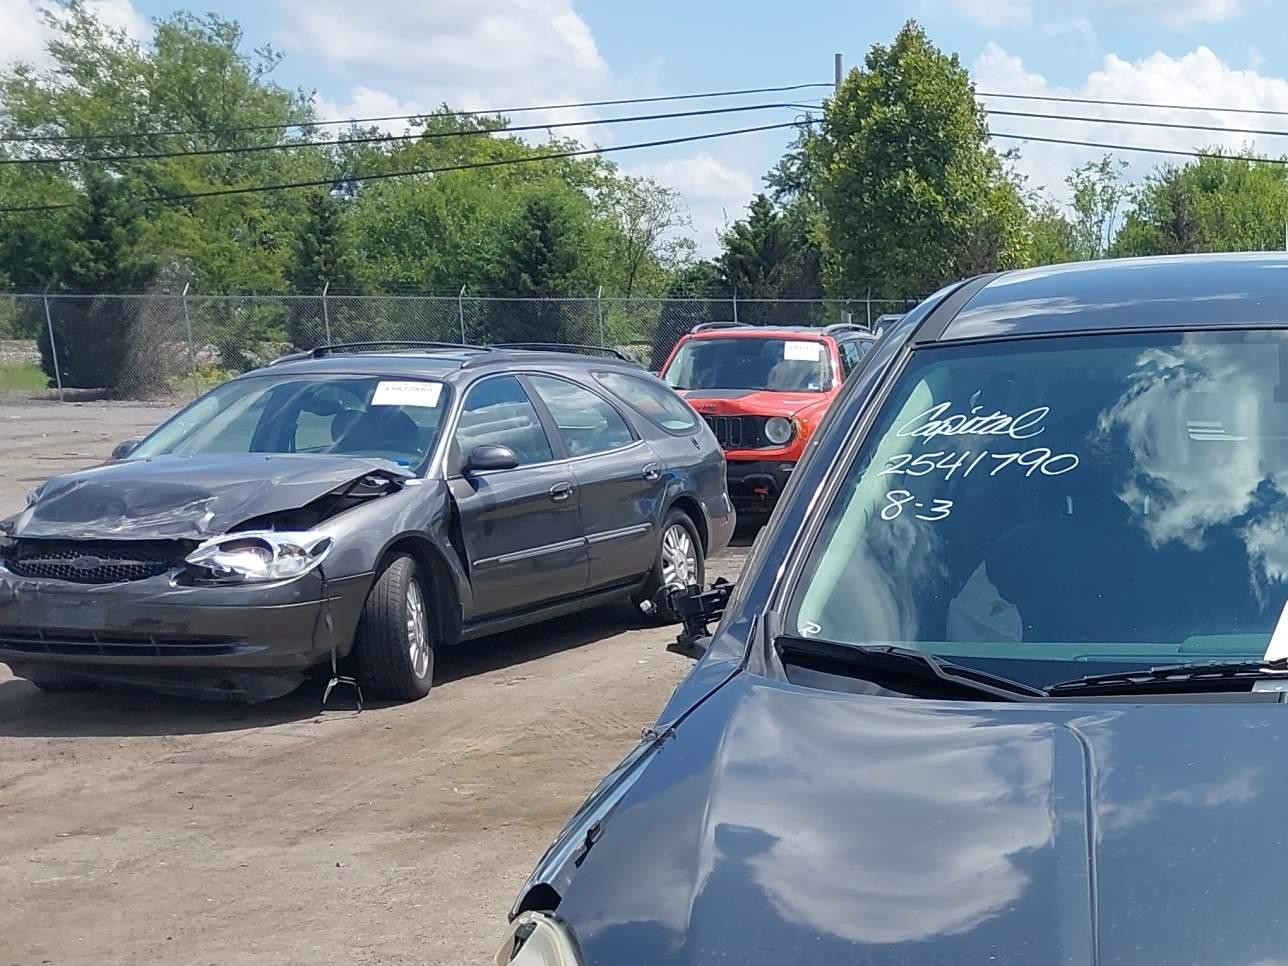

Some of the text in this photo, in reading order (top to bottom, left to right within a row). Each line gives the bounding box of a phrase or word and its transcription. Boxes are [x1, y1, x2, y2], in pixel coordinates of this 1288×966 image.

[896, 401, 1050, 446] Capital
[876, 447, 1080, 481] 2541790
[880, 489, 954, 521] 8-3
